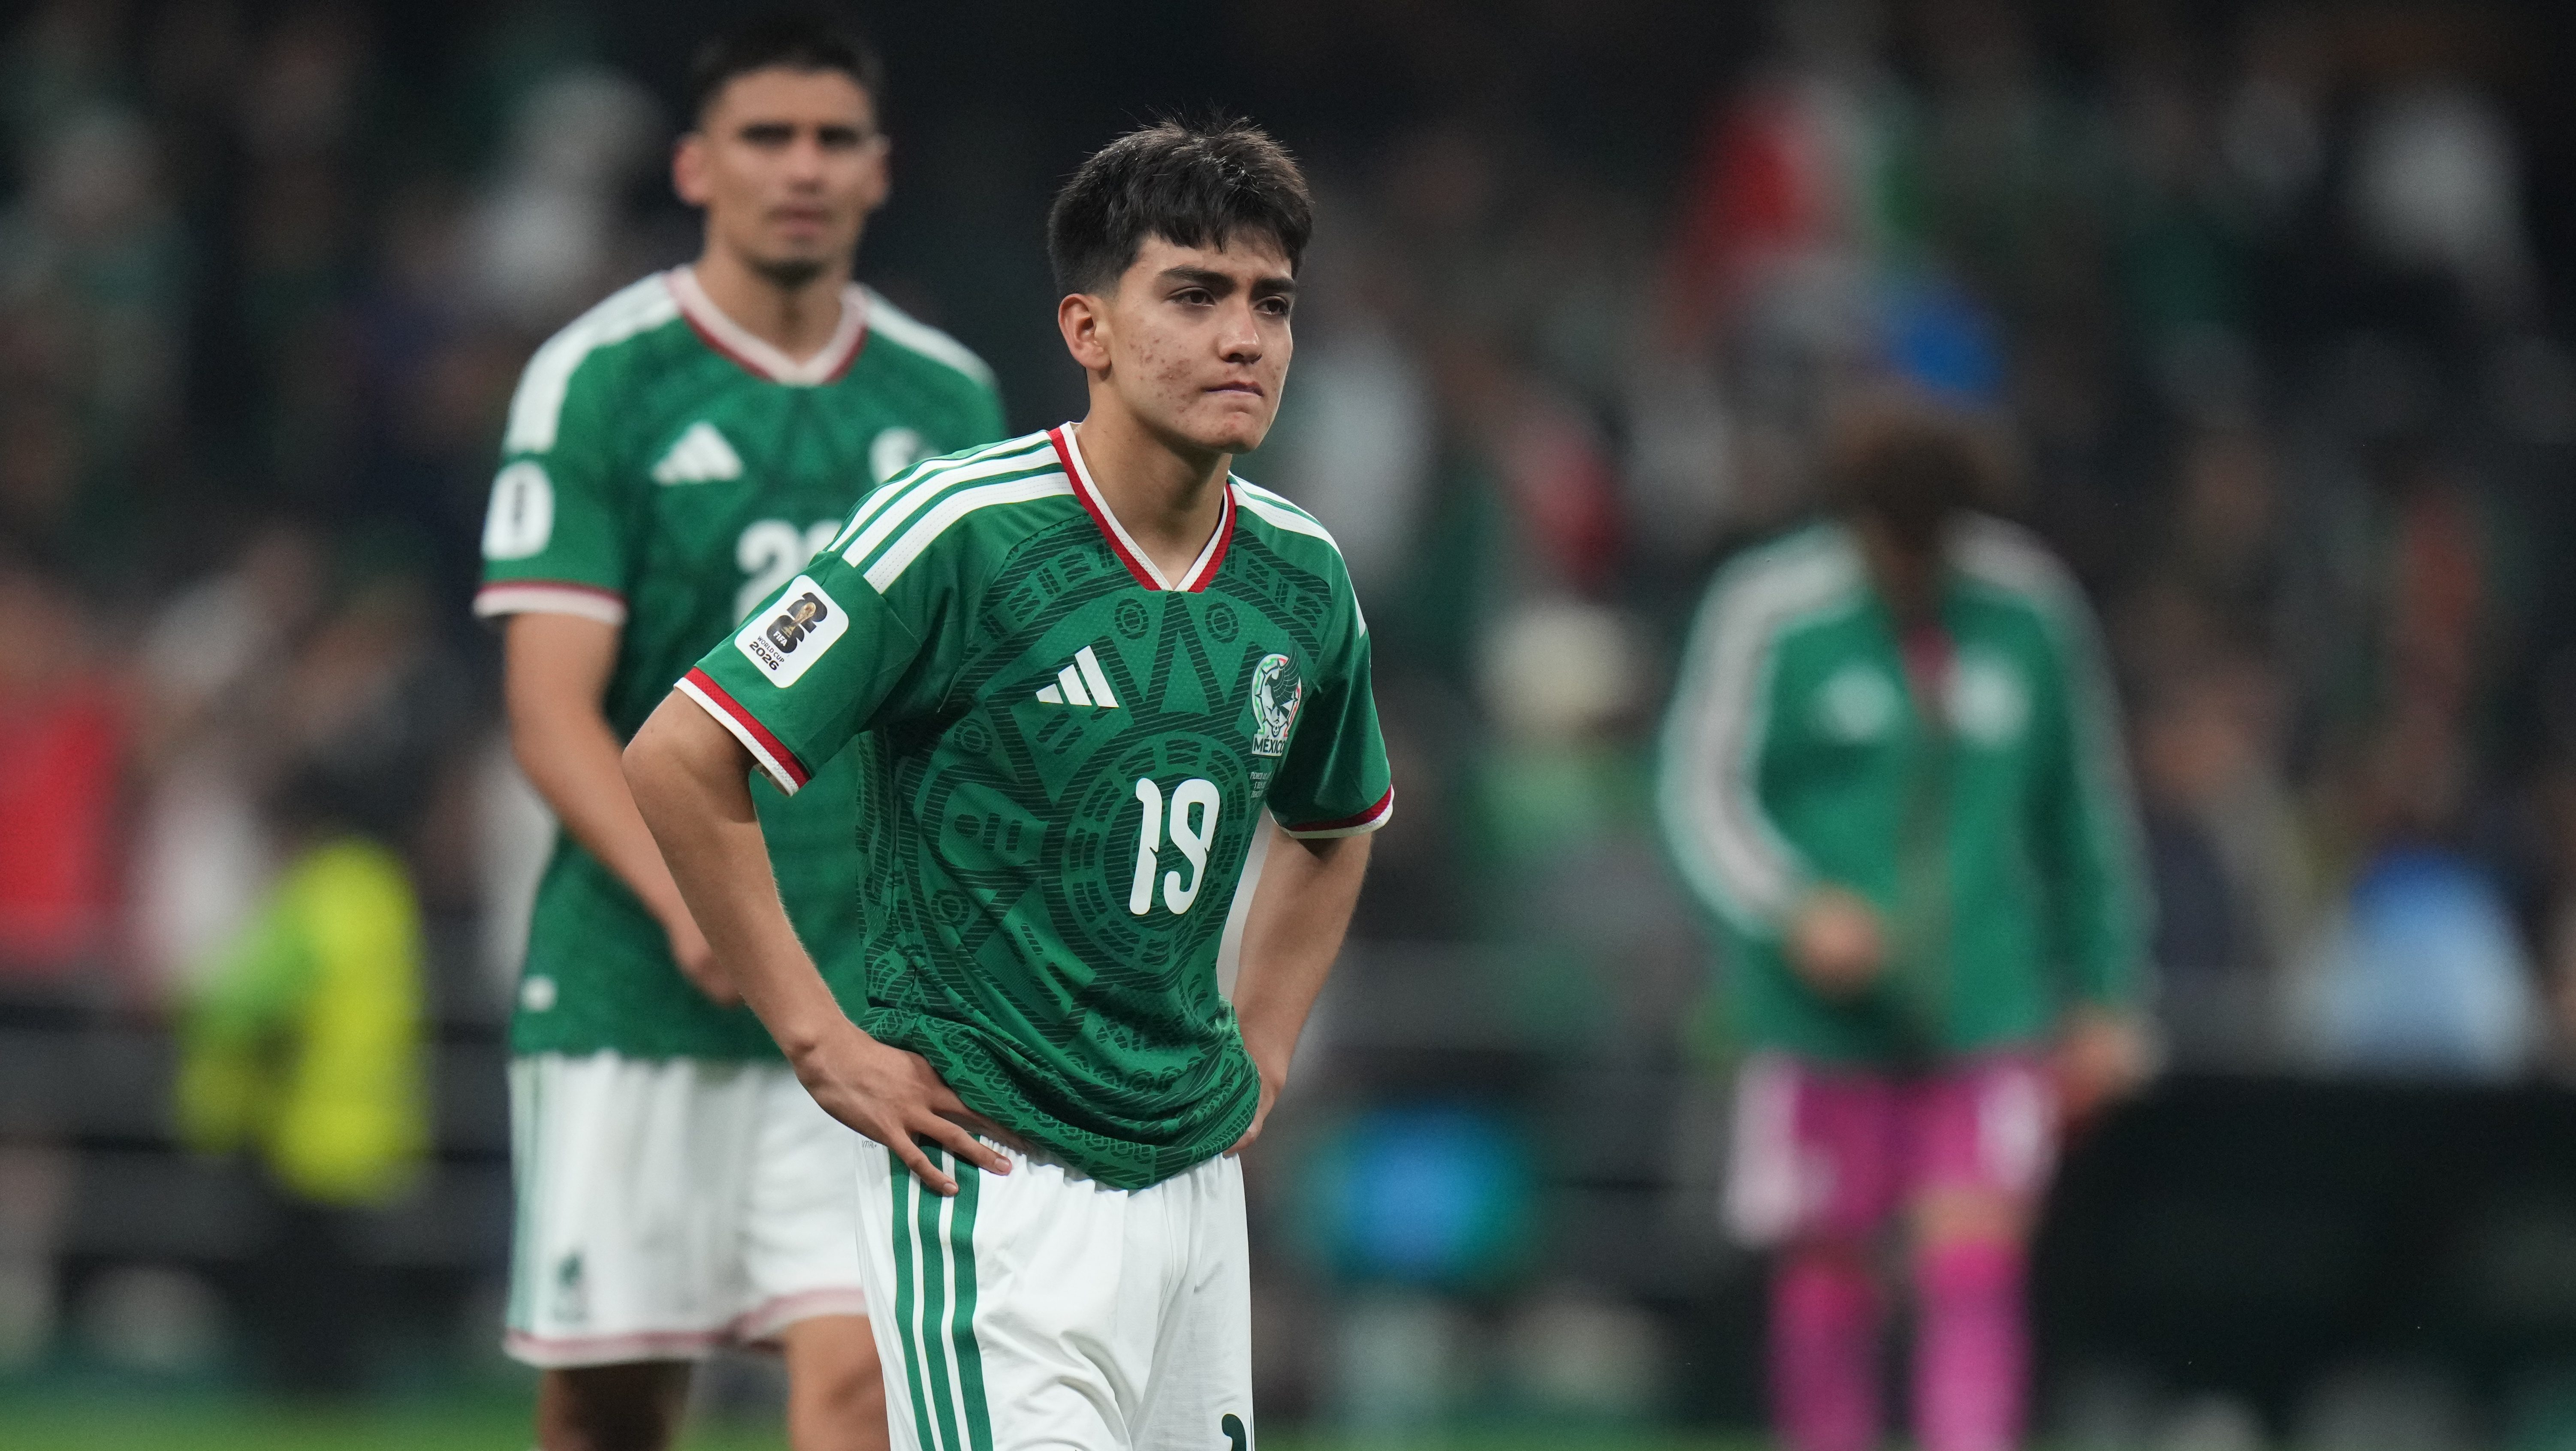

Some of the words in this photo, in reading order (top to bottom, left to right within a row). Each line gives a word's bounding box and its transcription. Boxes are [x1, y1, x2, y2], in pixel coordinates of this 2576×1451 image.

[757, 635, 774, 653] WORLD
[773, 652, 784, 663] CUP
[773, 630, 787, 647] FIFA
[749, 641, 779, 670] 2026
[1129, 778, 1220, 915] 19
